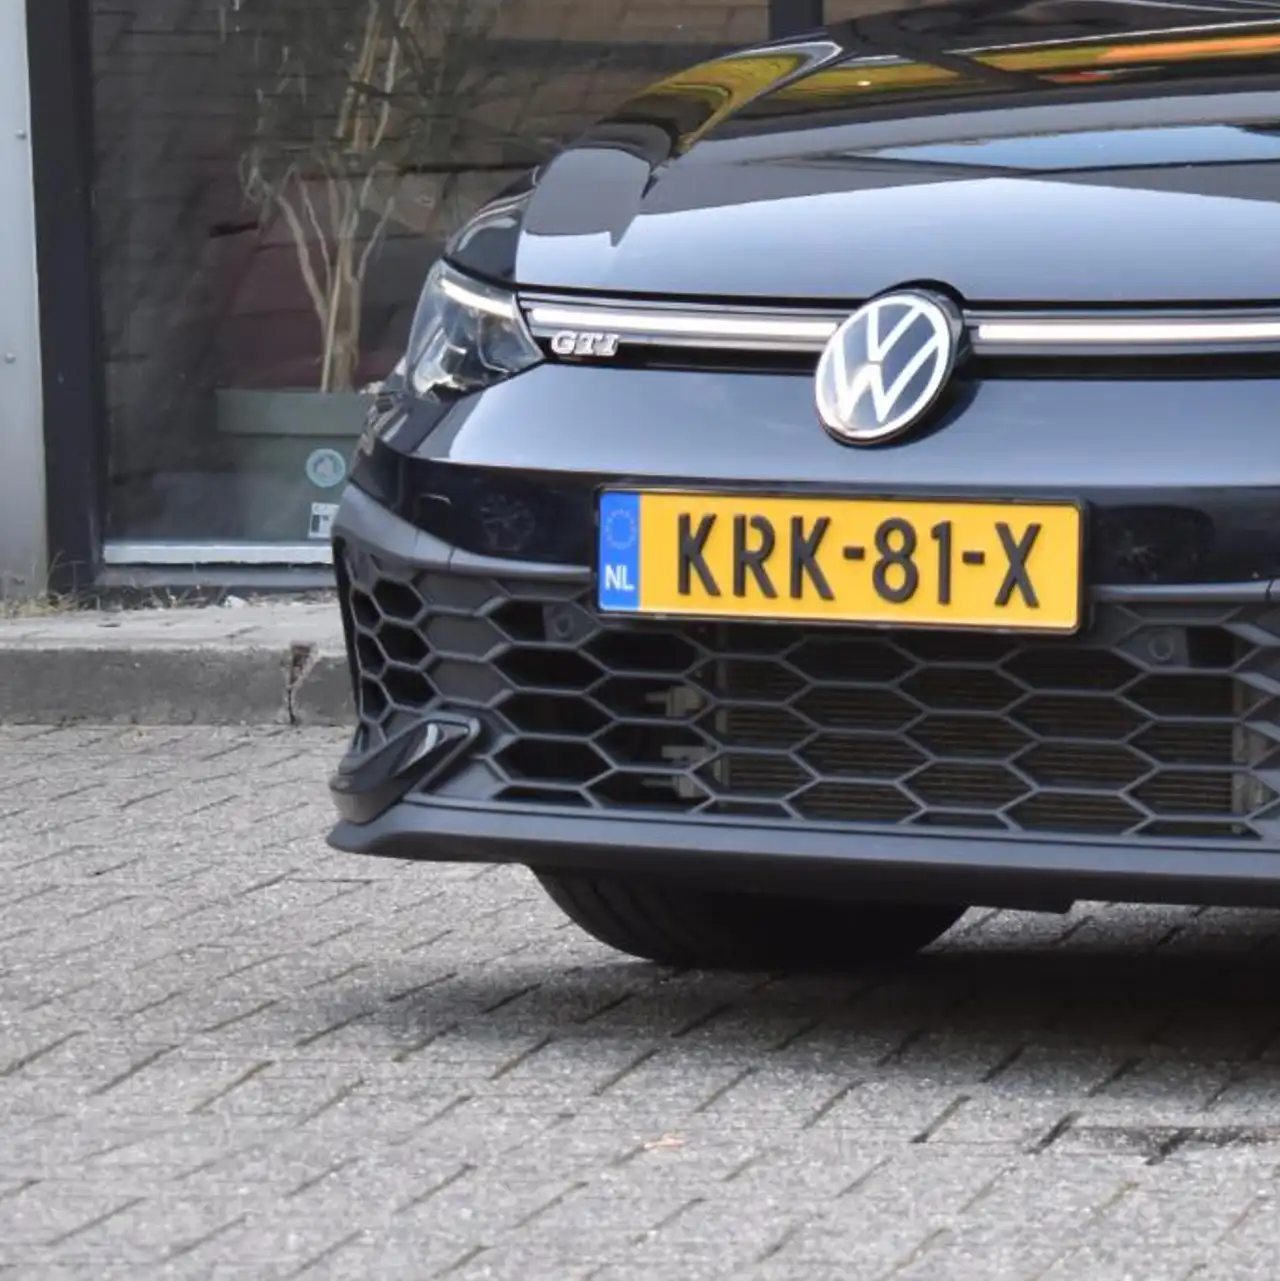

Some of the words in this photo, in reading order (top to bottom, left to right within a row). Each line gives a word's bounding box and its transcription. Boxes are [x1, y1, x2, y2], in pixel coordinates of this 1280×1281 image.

[551, 330, 620, 357] GTI
[604, 564, 635, 592] NL
[677, 513, 1042, 609] KRK-81-X
